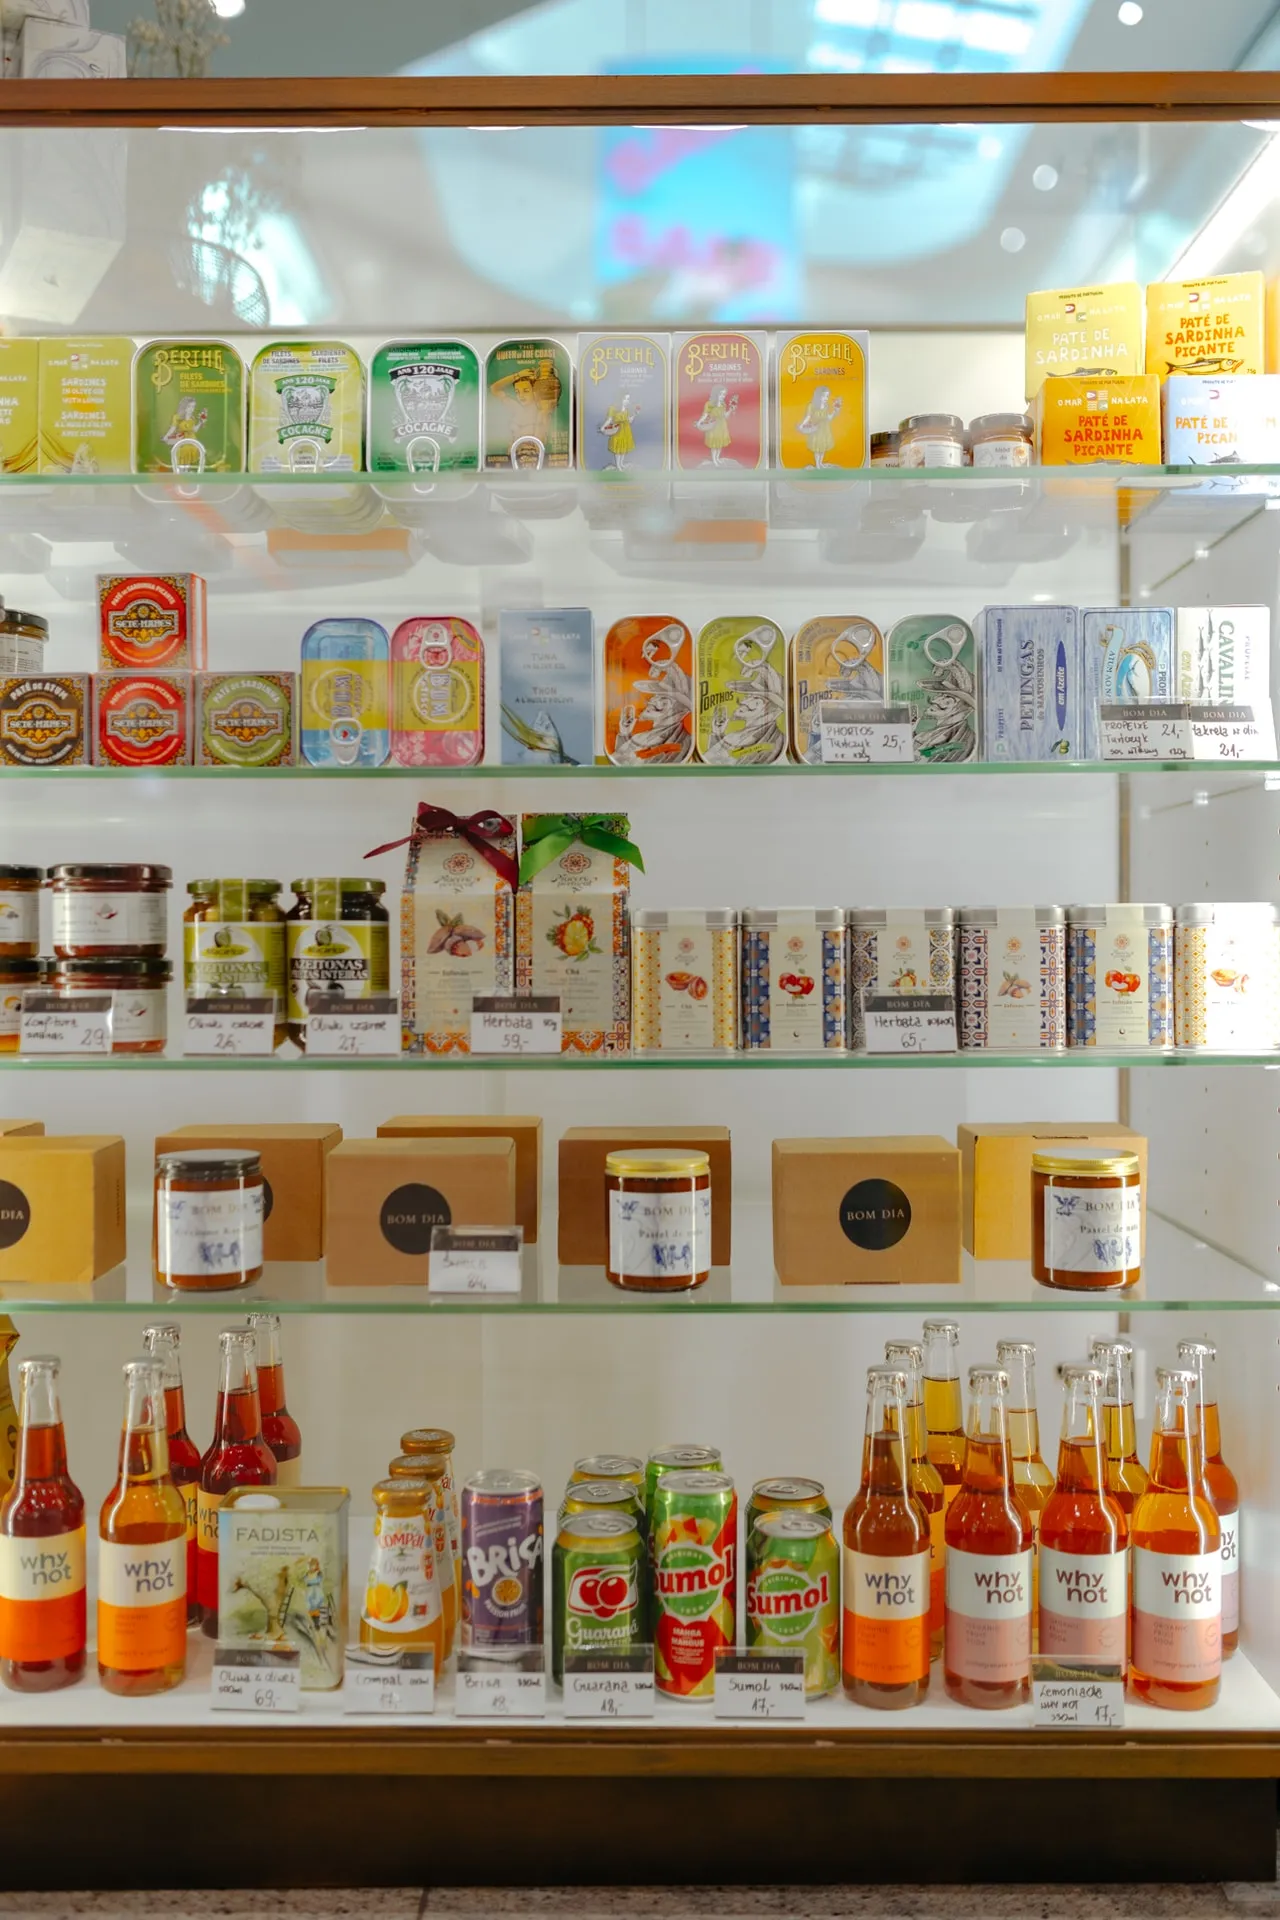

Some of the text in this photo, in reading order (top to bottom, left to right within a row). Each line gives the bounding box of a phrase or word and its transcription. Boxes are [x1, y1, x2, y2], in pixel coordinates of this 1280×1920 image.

[1179, 313, 1230, 330] PATÉ DE
[1052, 327, 1111, 346] PATÉ DE
[1165, 326, 1245, 346] SARDINHA
[1034, 342, 1129, 365] SARDINHA
[1175, 340, 1235, 358] PICANTE
[151, 349, 226, 394] BERTHE
[413, 365, 435, 375] 120
[589, 348, 656, 386] BERTHE
[685, 343, 753, 383] BERTHE
[708, 363, 743, 372] SARDINES
[787, 343, 854, 385] BERTHE
[1057, 396, 1149, 407] O MAR NA LATA
[397, 422, 454, 436] COCAGNE
[1078, 414, 1129, 427] PATÉ DE
[1175, 414, 1208, 430] PATÉ
[1213, 416, 1228, 430] DE
[280, 424, 329, 438] COCAGNE
[1064, 428, 1144, 443] SARDINHA
[1073, 443, 1134, 457] PICANTE
[531, 652, 558, 662] TUNA
[1106, 650, 1116, 673] ATUM
[1020, 638, 1035, 732] PETINGAS
[1037, 648, 1045, 709] MATOSINHOS
[1056, 666, 1065, 706] em Azeite
[9, 682, 70, 702] PATÉ ATUM
[213, 682, 230, 704] PATÉ
[331, 673, 353, 718] BOM
[429, 673, 451, 718] BOM
[532, 687, 558, 697] THON
[699, 680, 735, 716] PORTHOS
[799, 680, 833, 715] PORTHOS
[1122, 709, 1168, 718] BOM DIA
[1203, 711, 1247, 719] BOM DIA
[1104, 720, 1149, 731] PROPEIXE
[294, 960, 364, 971] AZEITONAS
[320, 970, 369, 980] INTEIRAS
[886, 1000, 931, 1009] BOM DIA
[482, 1013, 534, 1031] Herbata
[873, 1014, 923, 1028] Herbata
[0, 1209, 25, 1221] DIA
[644, 1206, 674, 1217] BOM
[847, 1208, 906, 1222] BOM DIA
[1085, 1201, 1115, 1213] BOM
[387, 1213, 446, 1225] BOM DIA
[638, 1230, 670, 1240] Pastel
[1080, 1224, 1111, 1234] Pastel
[199, 1507, 220, 1526] wh
[235, 1526, 320, 1543] FADISTA
[20, 1550, 68, 1571] why
[666, 1550, 704, 1563] ORIGINAL
[1220, 1543, 1237, 1561] ot
[32, 1564, 73, 1586] not
[124, 1558, 172, 1579] why
[135, 1571, 175, 1594] not
[764, 1574, 800, 1586] ORIGINAL
[864, 1572, 913, 1590] why
[973, 1570, 1022, 1588] why
[1055, 1568, 1105, 1588] why
[1160, 1570, 1210, 1589] why
[746, 1573, 831, 1617] Sumol
[876, 1587, 915, 1606] not
[986, 1584, 1024, 1605] not
[1066, 1584, 1108, 1604] not
[1173, 1584, 1213, 1604] not
[485, 1598, 528, 1618] PASSION FRUIT
[566, 1616, 639, 1648] Guaraná
[671, 1637, 705, 1648] MANGUE
[587, 1661, 631, 1670] BOM DIA
[737, 1660, 781, 1672] BOM DIA
[573, 1677, 631, 1694] Guarana
[728, 1679, 772, 1693] Sumol
[751, 1697, 776, 1716] 17,-
[1094, 1704, 1117, 1728] 17,-
